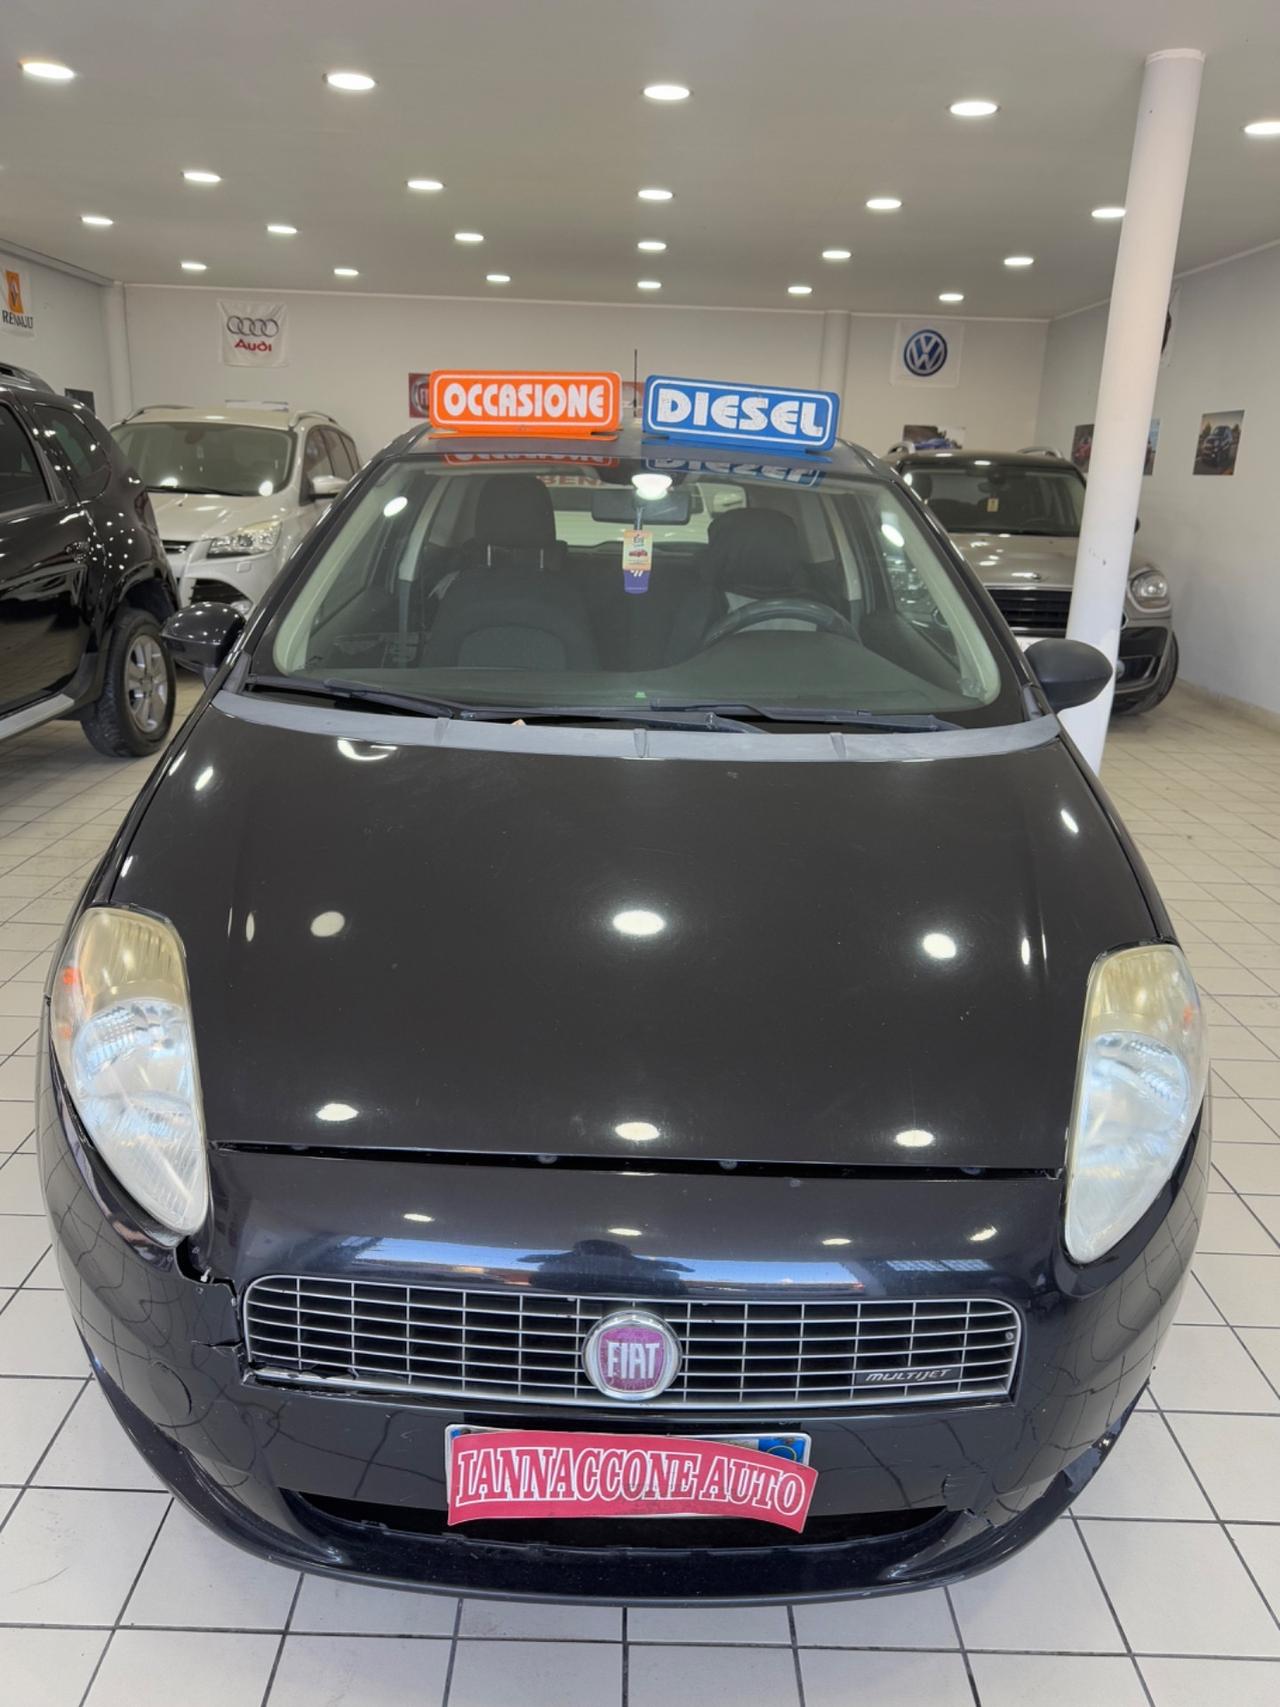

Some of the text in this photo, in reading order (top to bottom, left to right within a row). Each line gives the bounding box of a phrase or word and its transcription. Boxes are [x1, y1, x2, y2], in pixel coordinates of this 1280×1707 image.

[443, 382, 605, 418] OCCASIONE
[656, 388, 824, 438] DIESEL
[606, 1341, 660, 1380] FIAT
[455, 1446, 806, 1516] IANNACCONE AUTO
